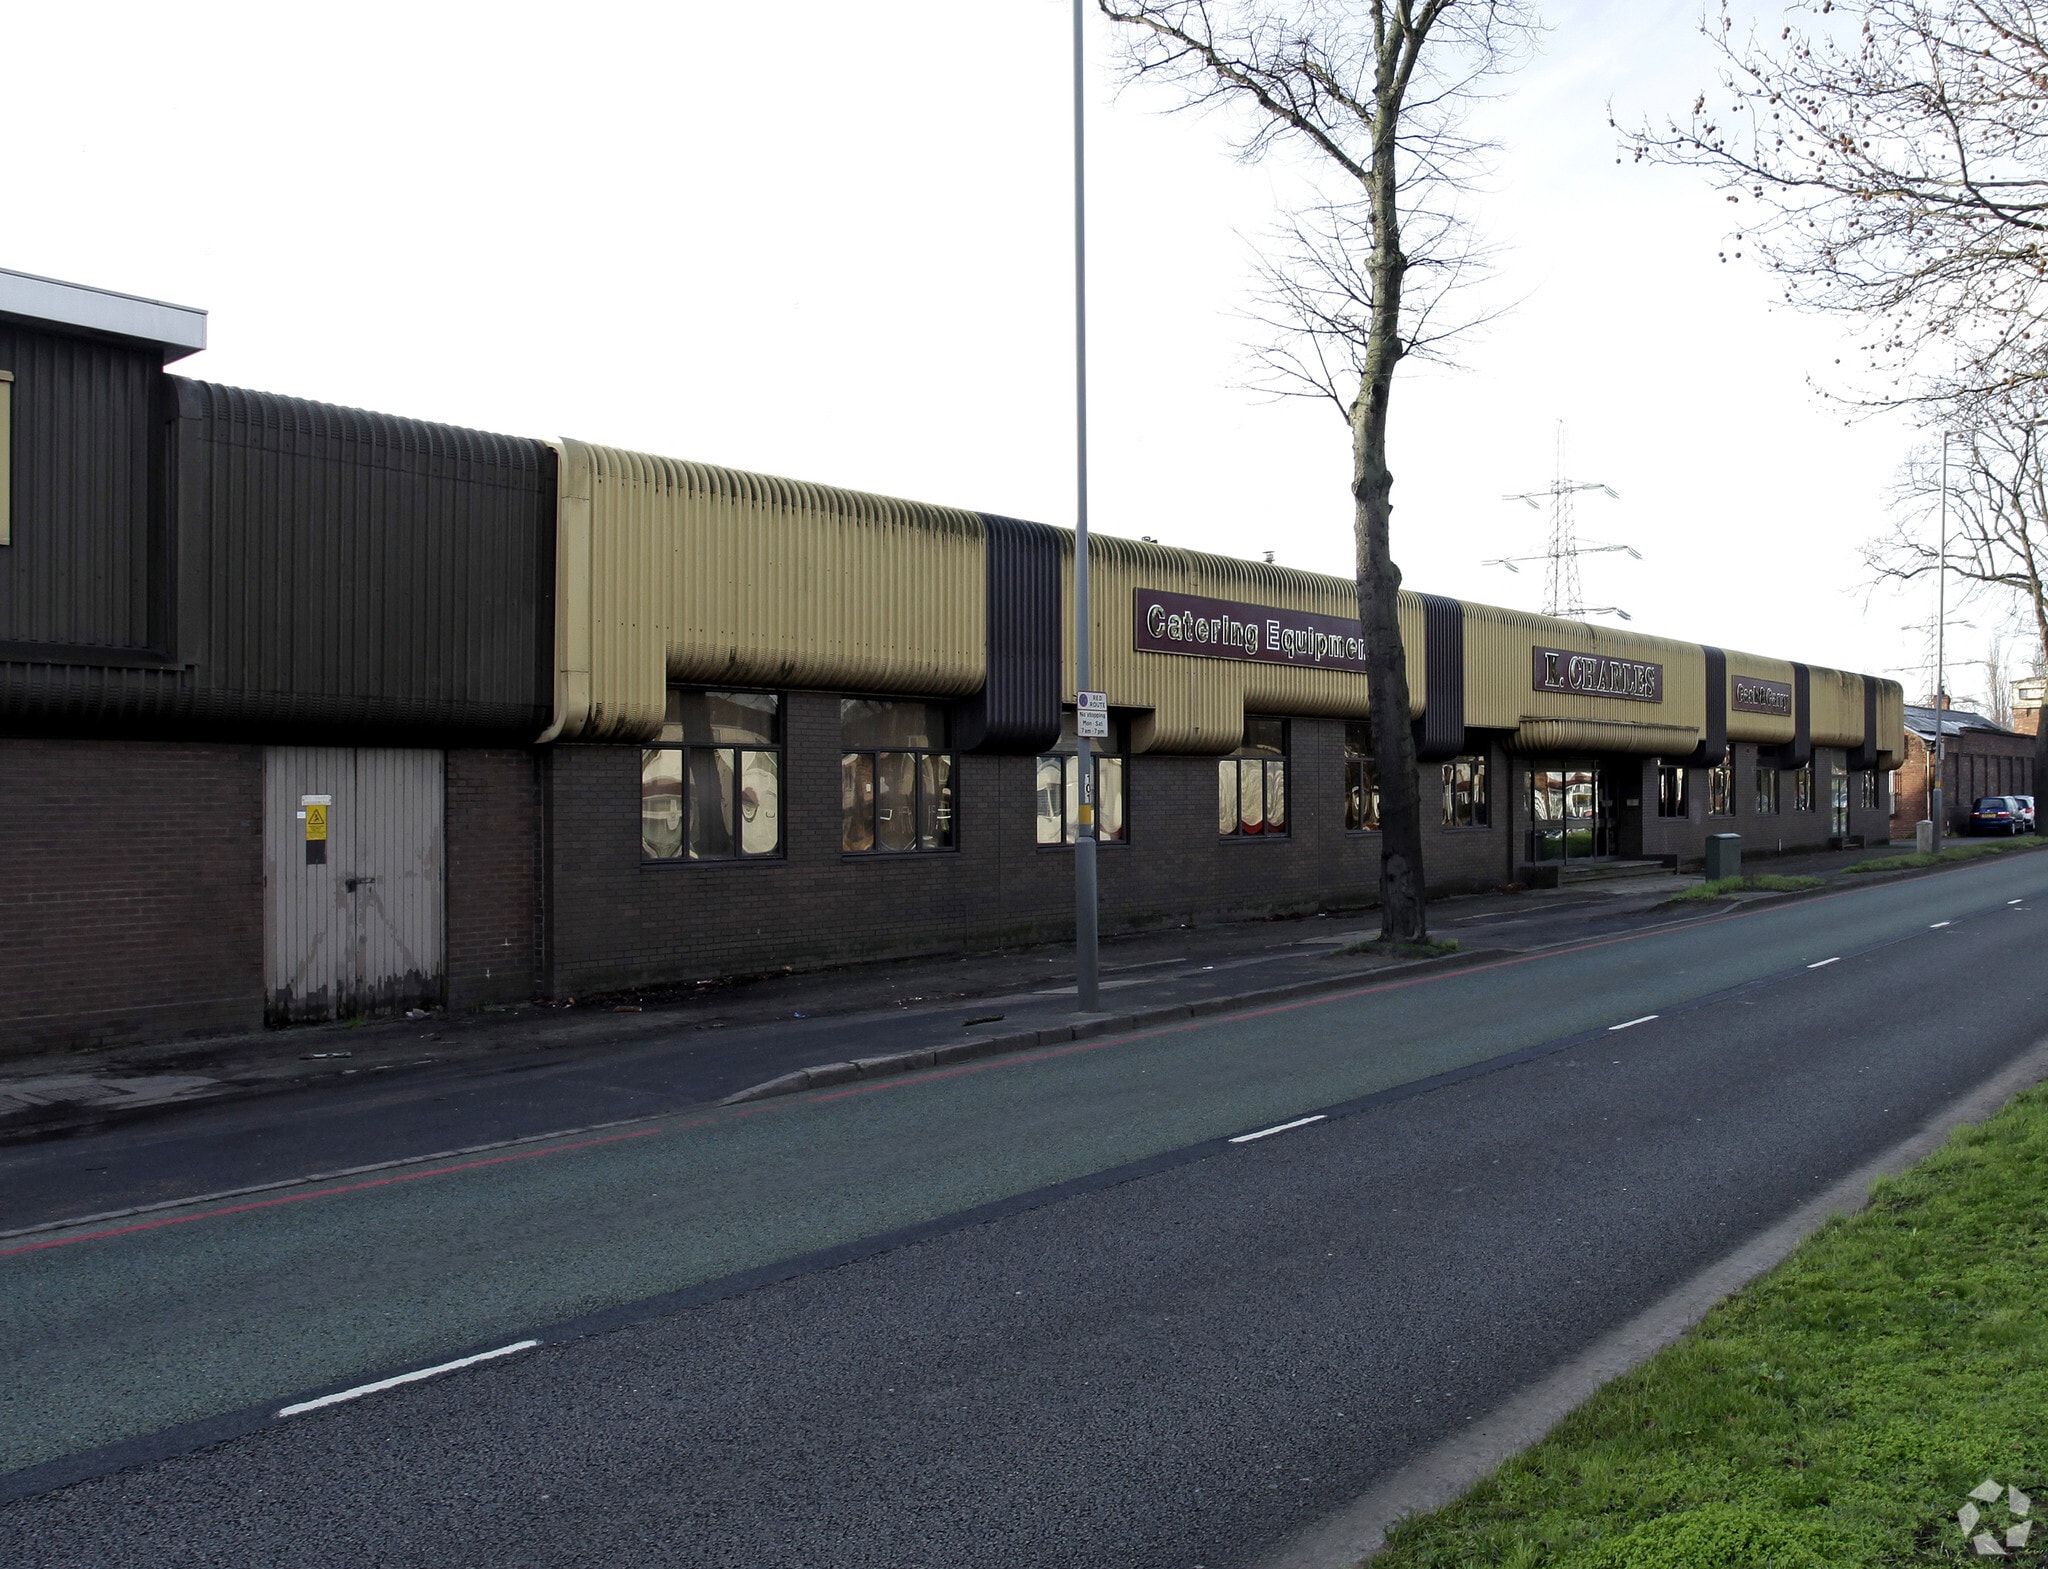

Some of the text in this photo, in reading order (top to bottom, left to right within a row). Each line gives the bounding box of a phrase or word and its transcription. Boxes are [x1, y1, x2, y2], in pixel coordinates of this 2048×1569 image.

[1147, 604, 1366, 661] Catering Equipmen
[1544, 652, 1655, 698] K. CHARLES
[1736, 683, 1758, 705] Cash
[1766, 687, 1789, 712] Carry
